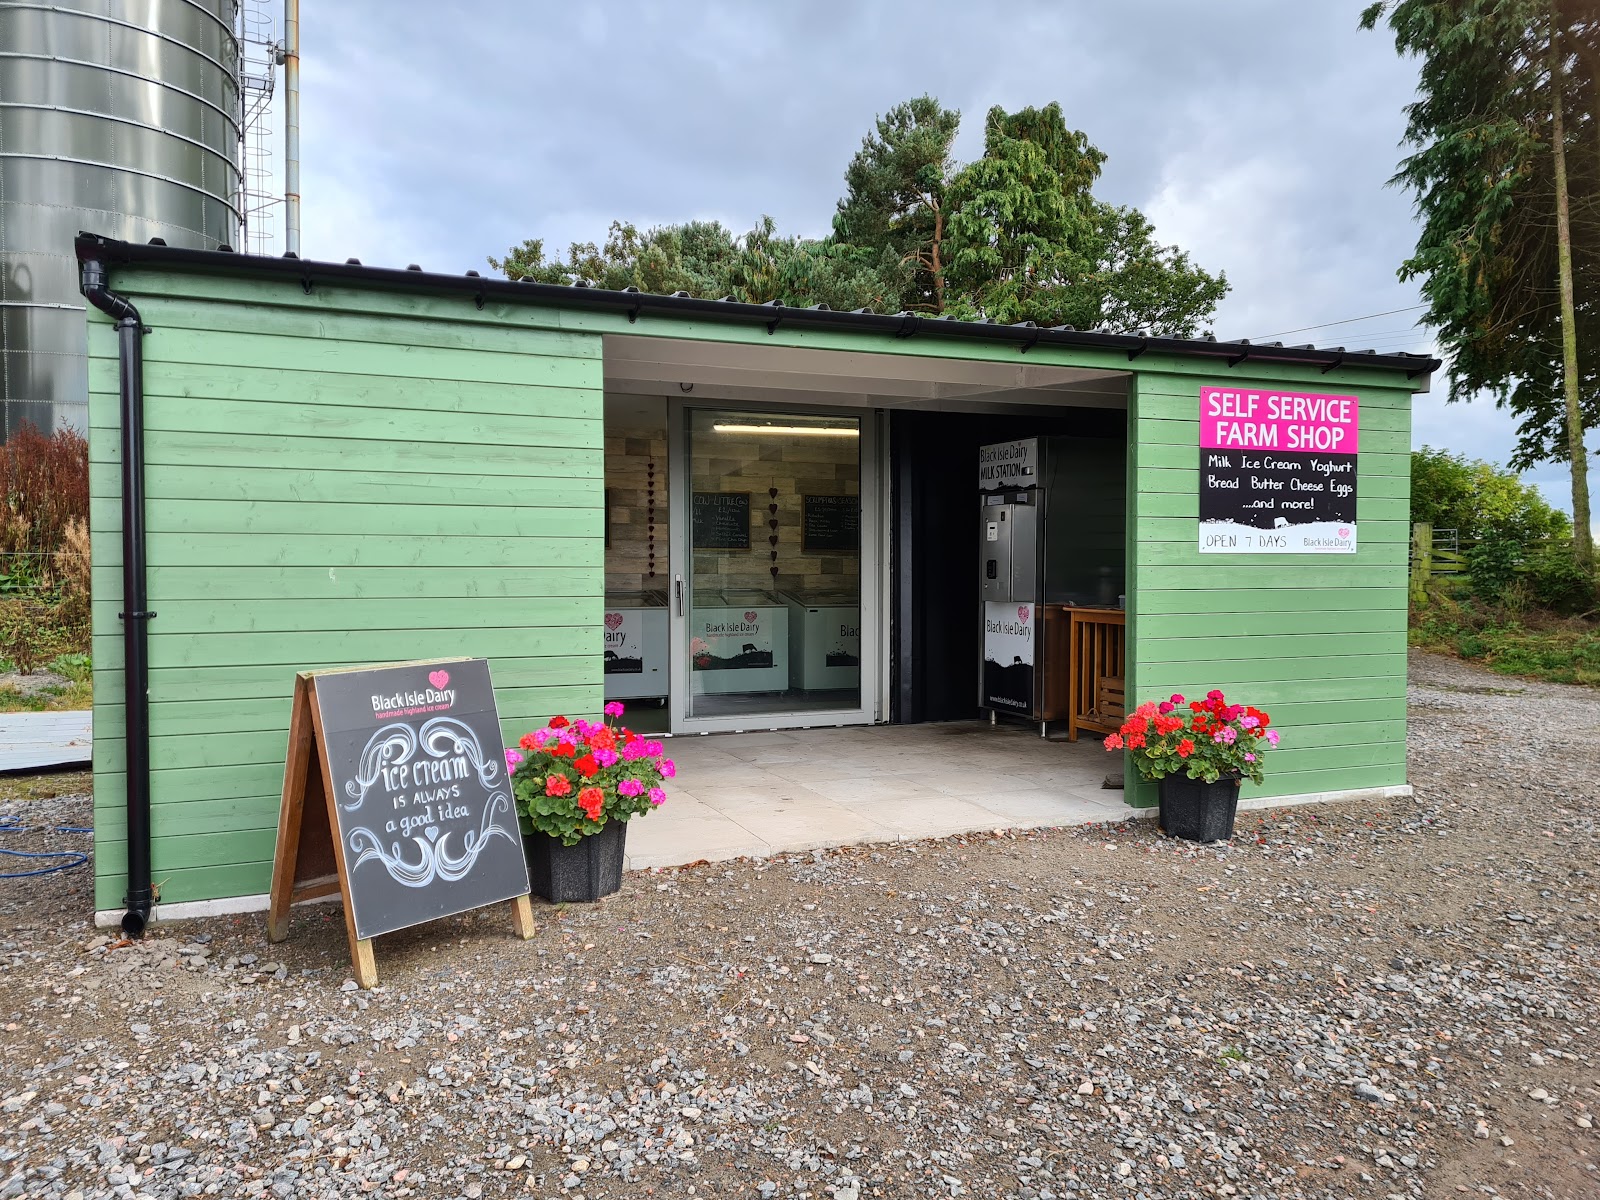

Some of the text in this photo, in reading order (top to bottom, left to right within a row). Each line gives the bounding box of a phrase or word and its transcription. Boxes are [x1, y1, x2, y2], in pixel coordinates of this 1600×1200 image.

[1208, 392, 1352, 424] SELF SERVICE
[1216, 421, 1345, 450] FARM SHOP
[981, 444, 1028, 464] Black Isle Dairy
[980, 462, 1021, 480] MILK STATION
[1208, 455, 1353, 477] Milk Ice Cream Yoghurt
[1208, 475, 1354, 497] Bread Butter Cheese Eggs
[1282, 497, 1315, 509] more!
[1206, 534, 1287, 548] OPEN 7 DAYS
[1303, 537, 1352, 551] Black Isle Dairy
[706, 622, 760, 635] Black Isle Dairy
[986, 619, 1031, 642] Black Isle Dairy
[371, 688, 455, 711] Black Isle Dairy
[375, 703, 450, 719] handmade highland ice cream
[381, 756, 470, 792] ice cream
[393, 784, 460, 810] IS ALWAYS
[385, 802, 470, 837] a good idea
